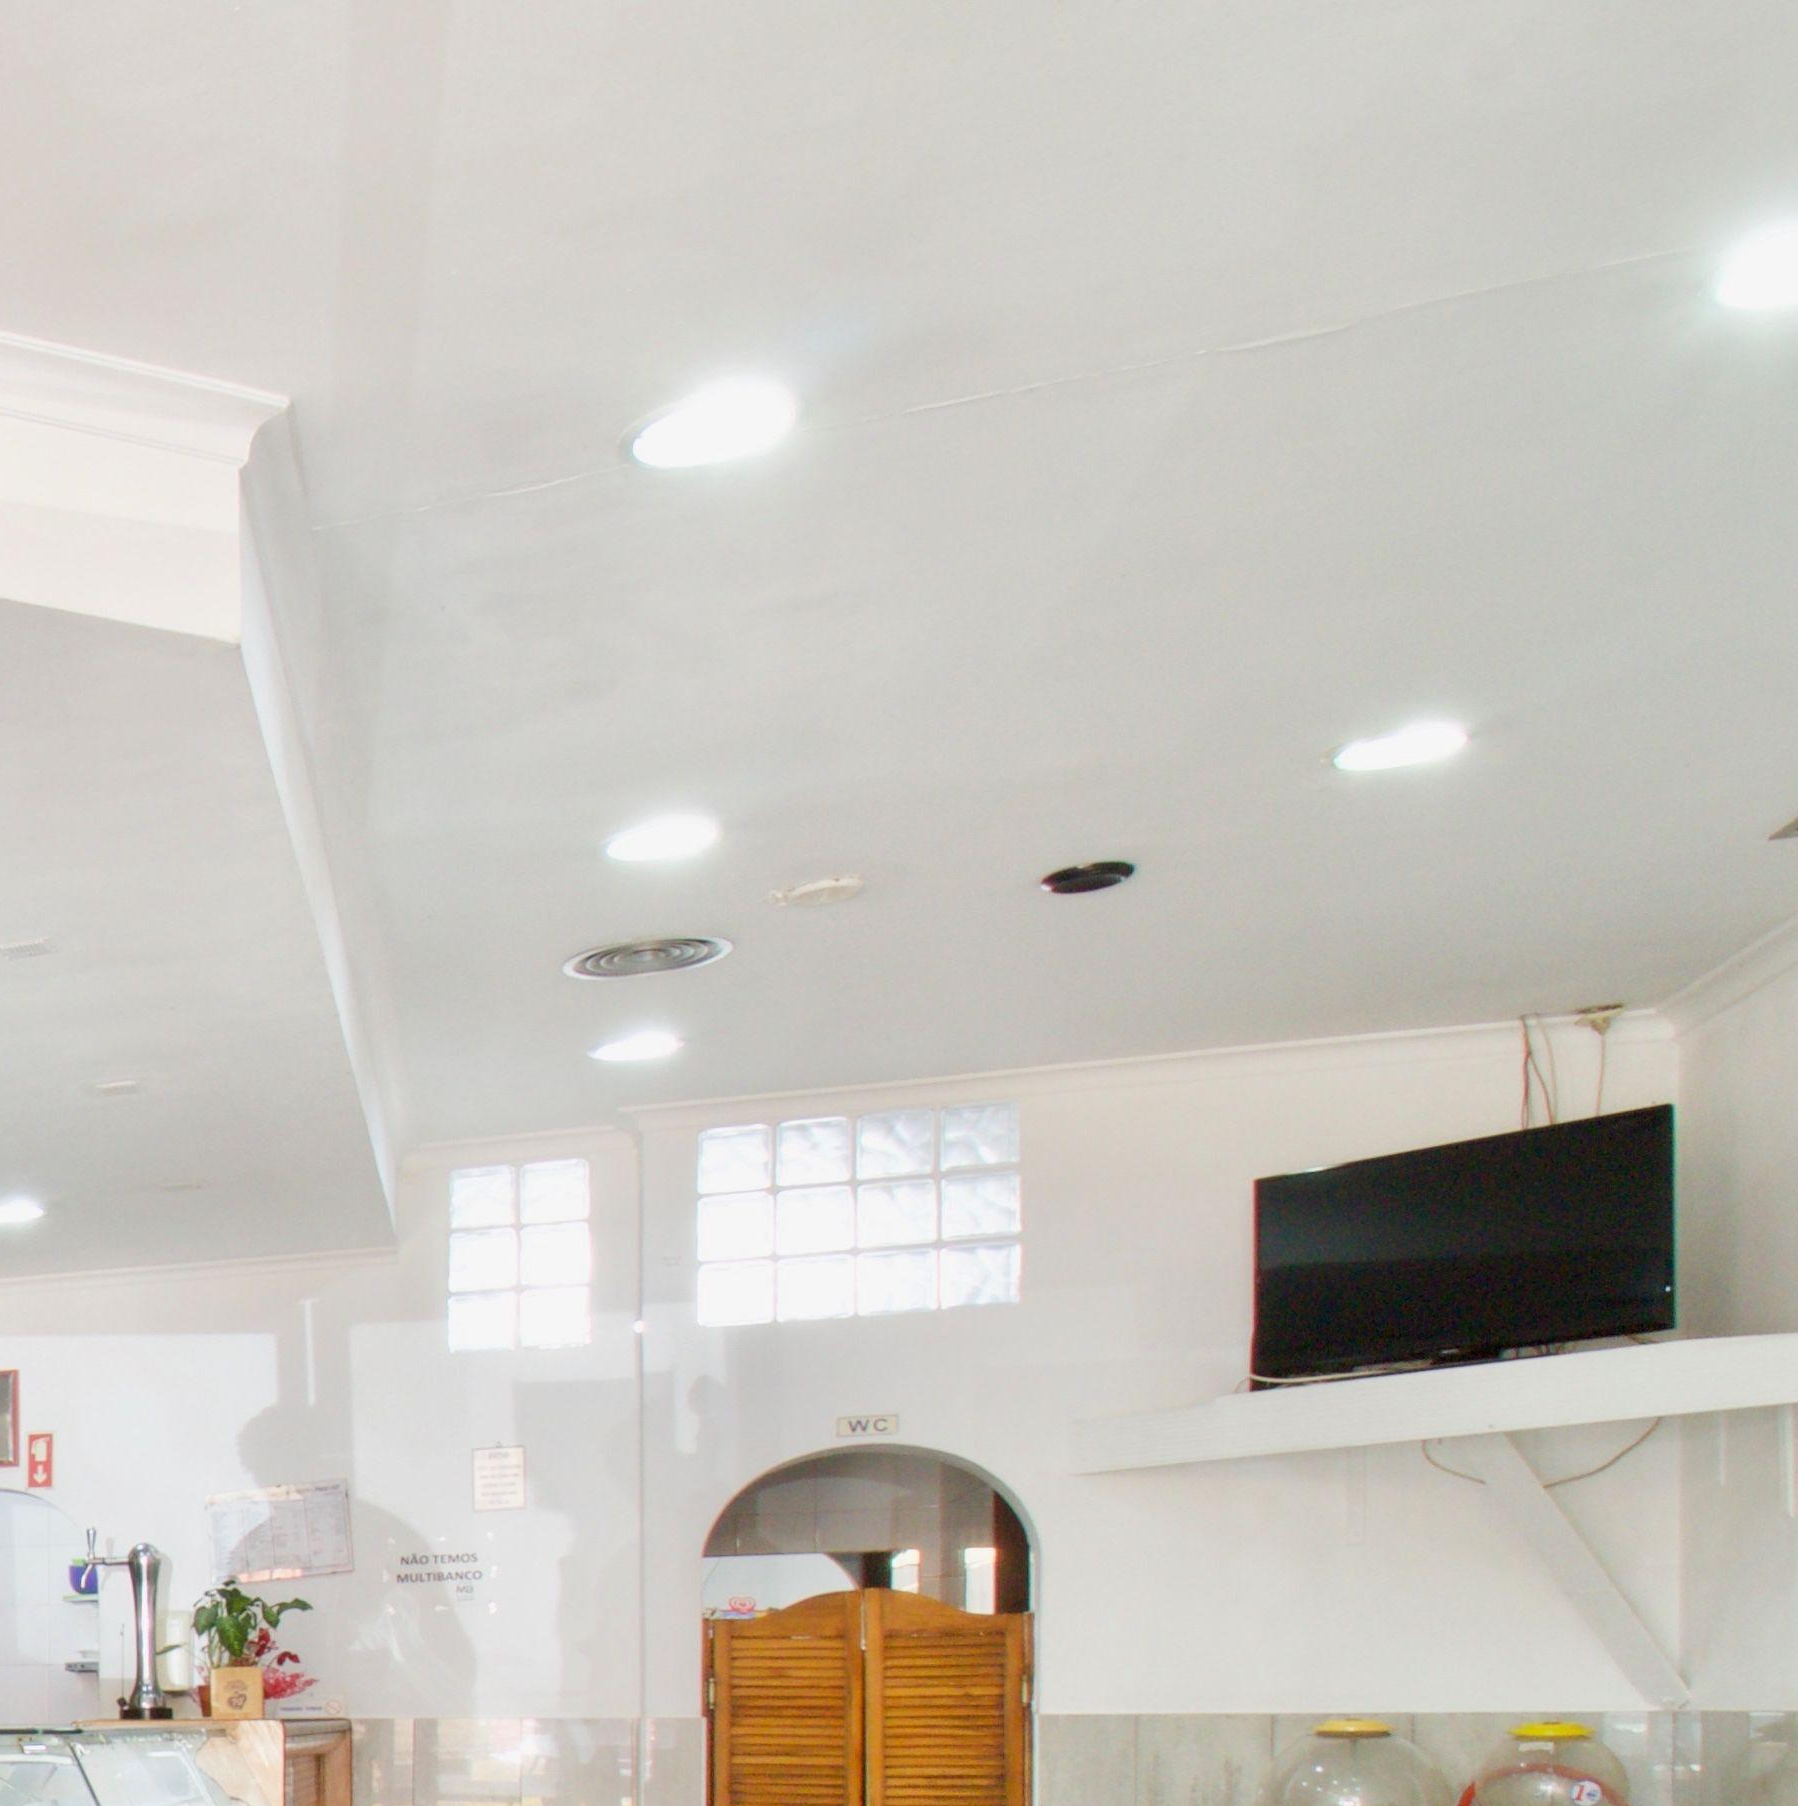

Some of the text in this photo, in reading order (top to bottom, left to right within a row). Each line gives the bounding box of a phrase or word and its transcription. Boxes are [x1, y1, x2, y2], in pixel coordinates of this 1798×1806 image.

[848, 1418, 888, 1432] WC
[400, 1552, 478, 1565] NÃO TEMOS
[396, 1570, 483, 1583] MULTIBANCO
